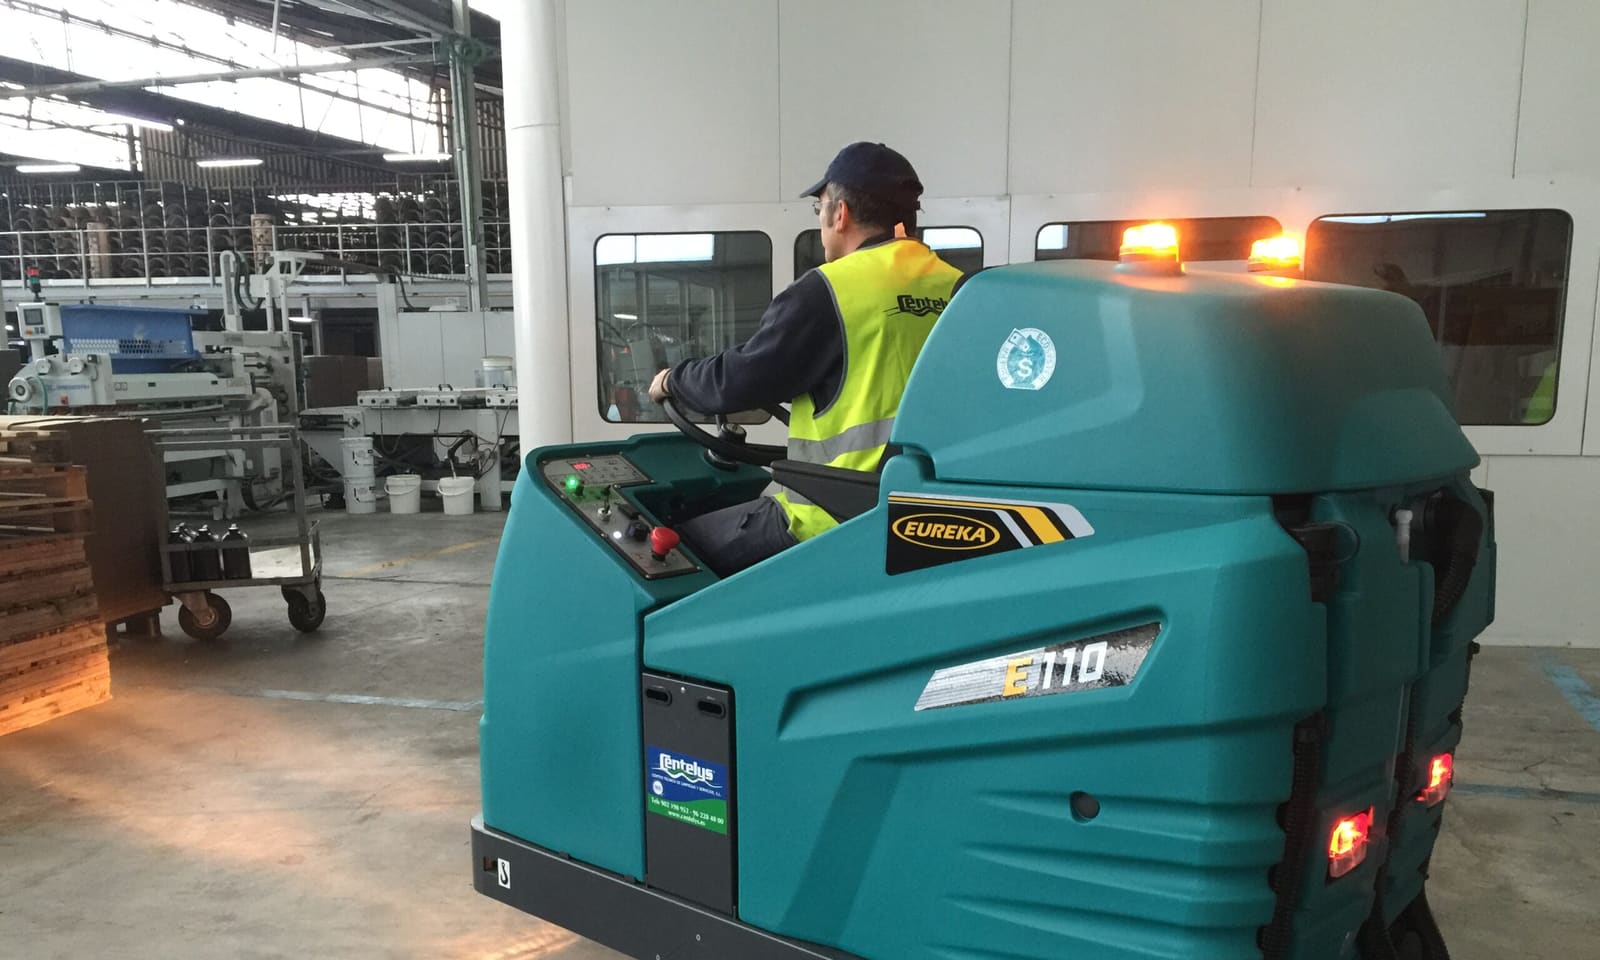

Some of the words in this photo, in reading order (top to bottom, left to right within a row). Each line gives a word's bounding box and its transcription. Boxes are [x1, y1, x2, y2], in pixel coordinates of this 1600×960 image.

[897, 294, 948, 312] Centel
[904, 521, 986, 543] EUREKA
[660, 752, 714, 781] Centelys
